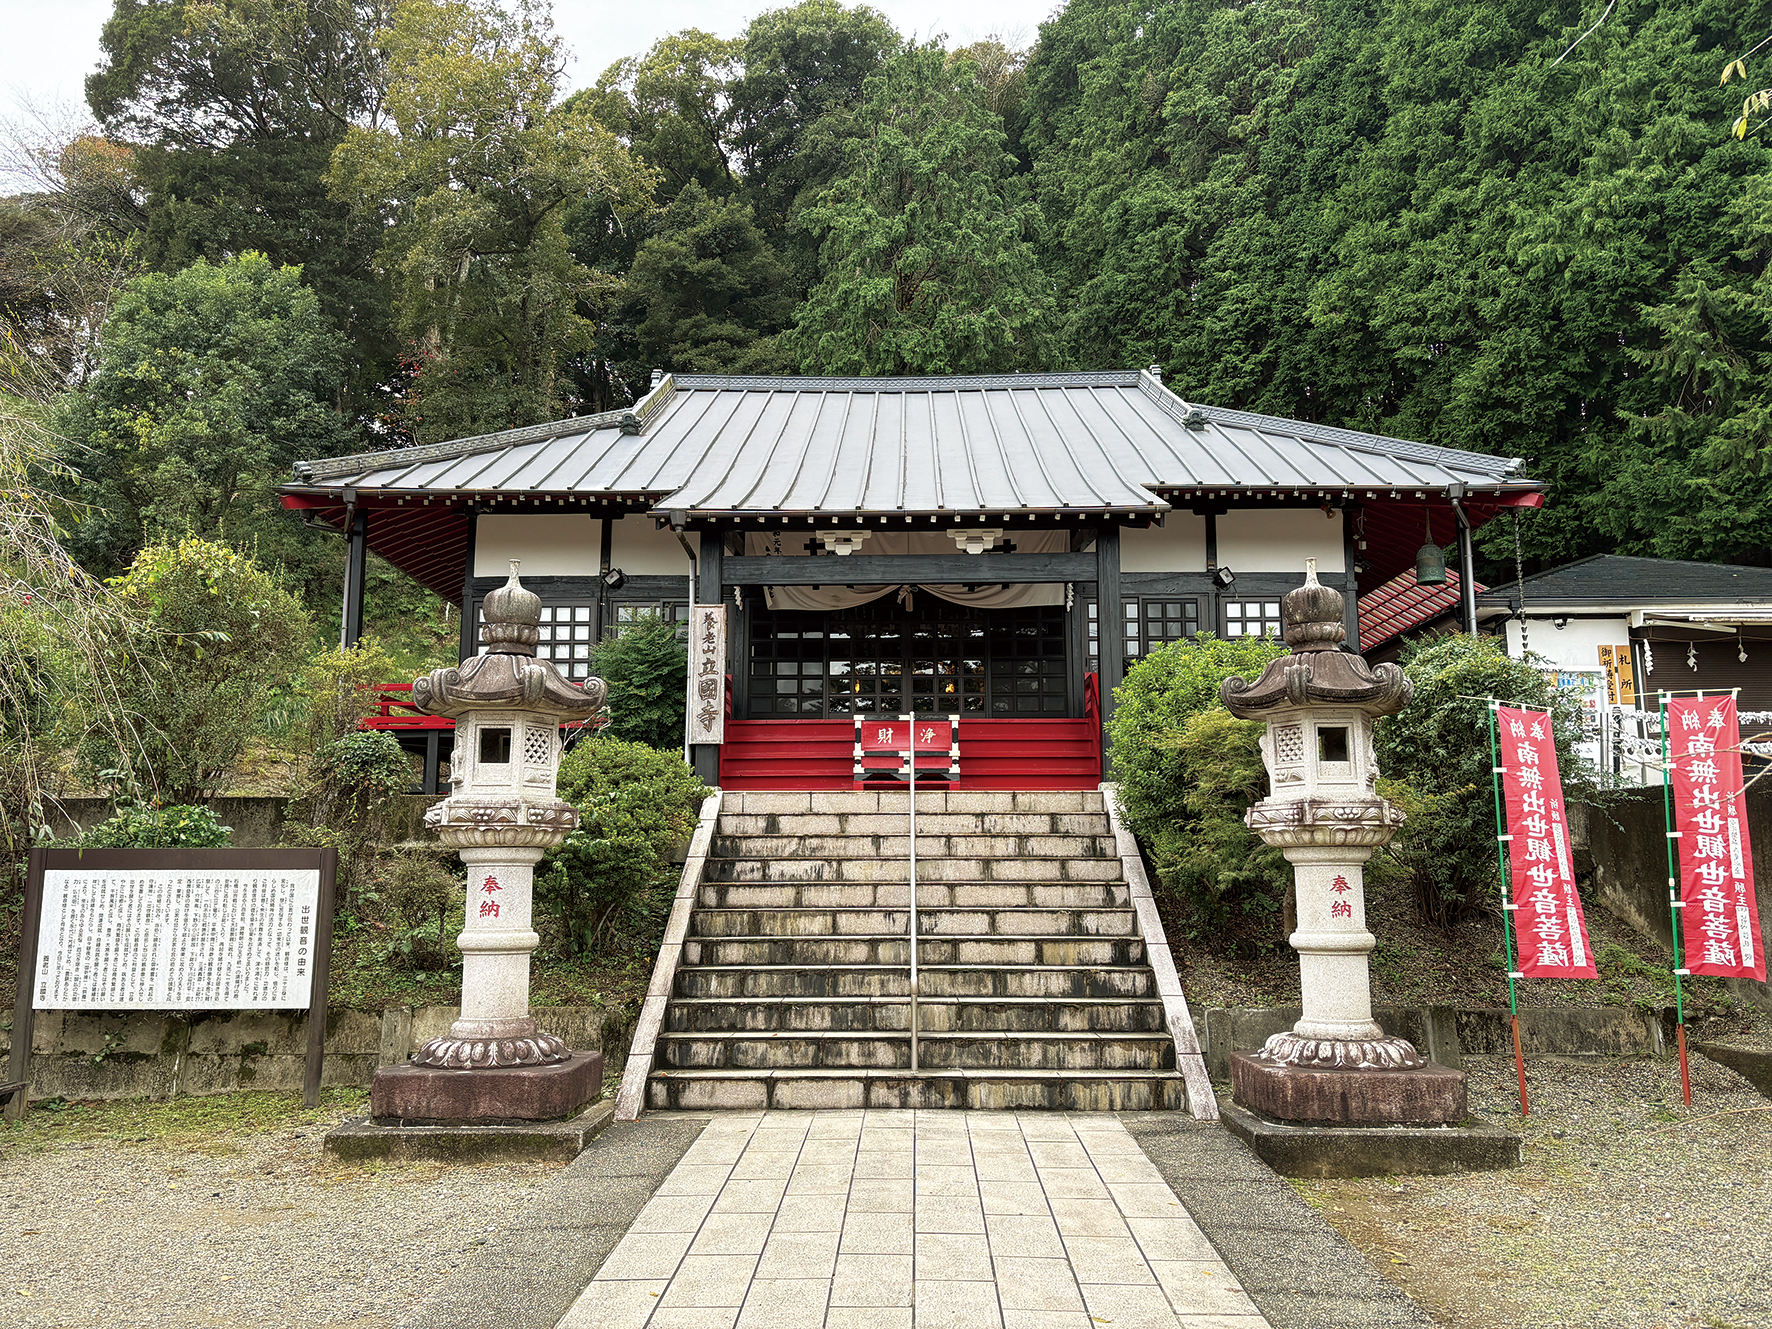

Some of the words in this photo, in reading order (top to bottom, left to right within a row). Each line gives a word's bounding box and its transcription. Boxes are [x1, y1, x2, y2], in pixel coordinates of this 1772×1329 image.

[1619, 654, 1632, 691] 札所
[480, 875, 503, 919] 奉納
[1330, 874, 1352, 919] 奉納
[296, 905, 311, 977] 出世観音の由来
